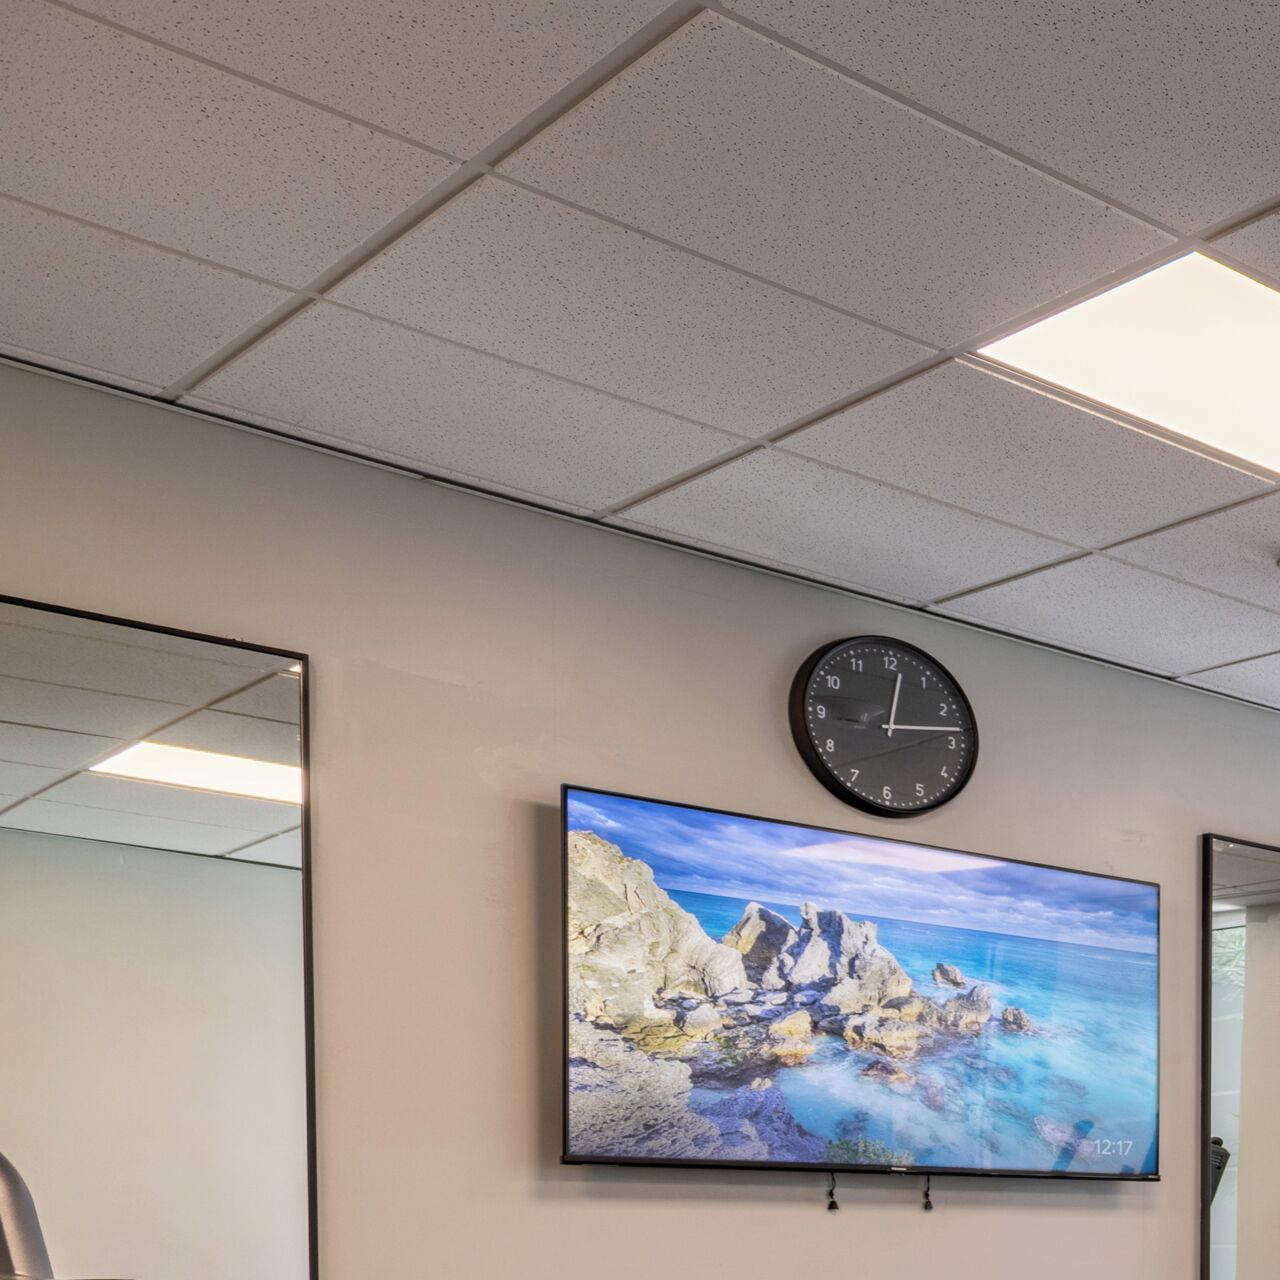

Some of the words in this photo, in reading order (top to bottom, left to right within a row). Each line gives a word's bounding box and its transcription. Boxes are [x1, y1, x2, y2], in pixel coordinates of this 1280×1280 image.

[851, 658, 863, 672] 11
[884, 657, 898, 671] 12
[826, 676, 840, 689] 10
[921, 677, 926, 688] 1
[817, 706, 825, 718] 9
[940, 704, 947, 716] 2
[826, 739, 834, 752] 8
[948, 737, 955, 749] 3
[851, 769, 859, 782] 7
[940, 767, 948, 778] 4
[883, 786, 891, 799] 6
[916, 784, 924, 796] 5
[1095, 1139, 1133, 1155] 12:17
